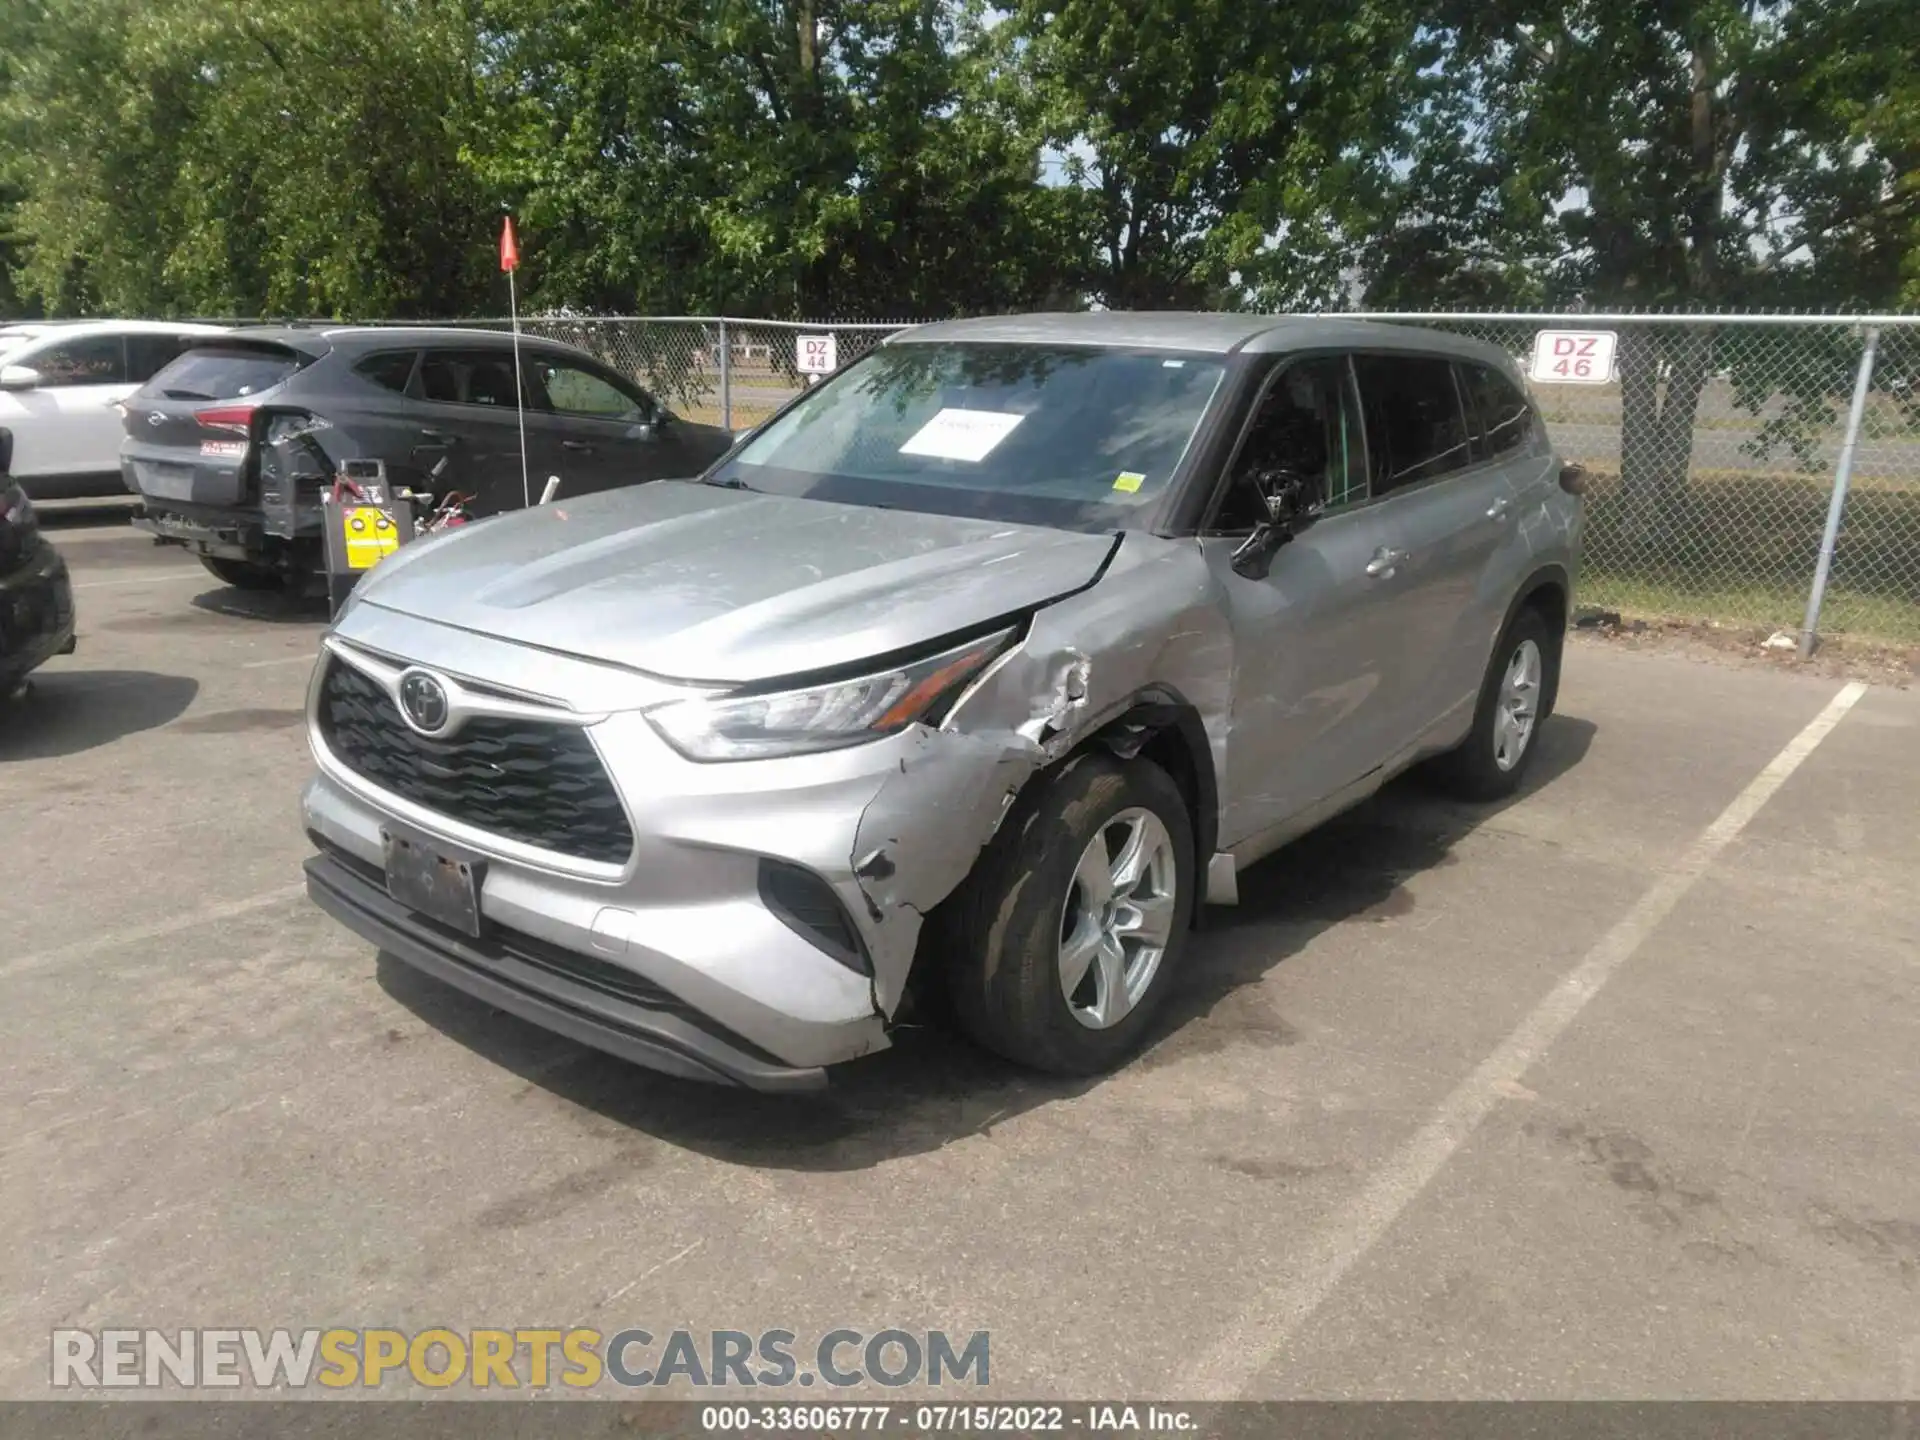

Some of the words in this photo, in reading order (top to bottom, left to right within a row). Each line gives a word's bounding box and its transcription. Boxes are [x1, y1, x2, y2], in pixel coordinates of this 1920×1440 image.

[806, 341, 827, 354] DZ
[1554, 338, 1598, 356] DZ
[808, 356, 825, 368] 44
[1552, 359, 1591, 377] 46
